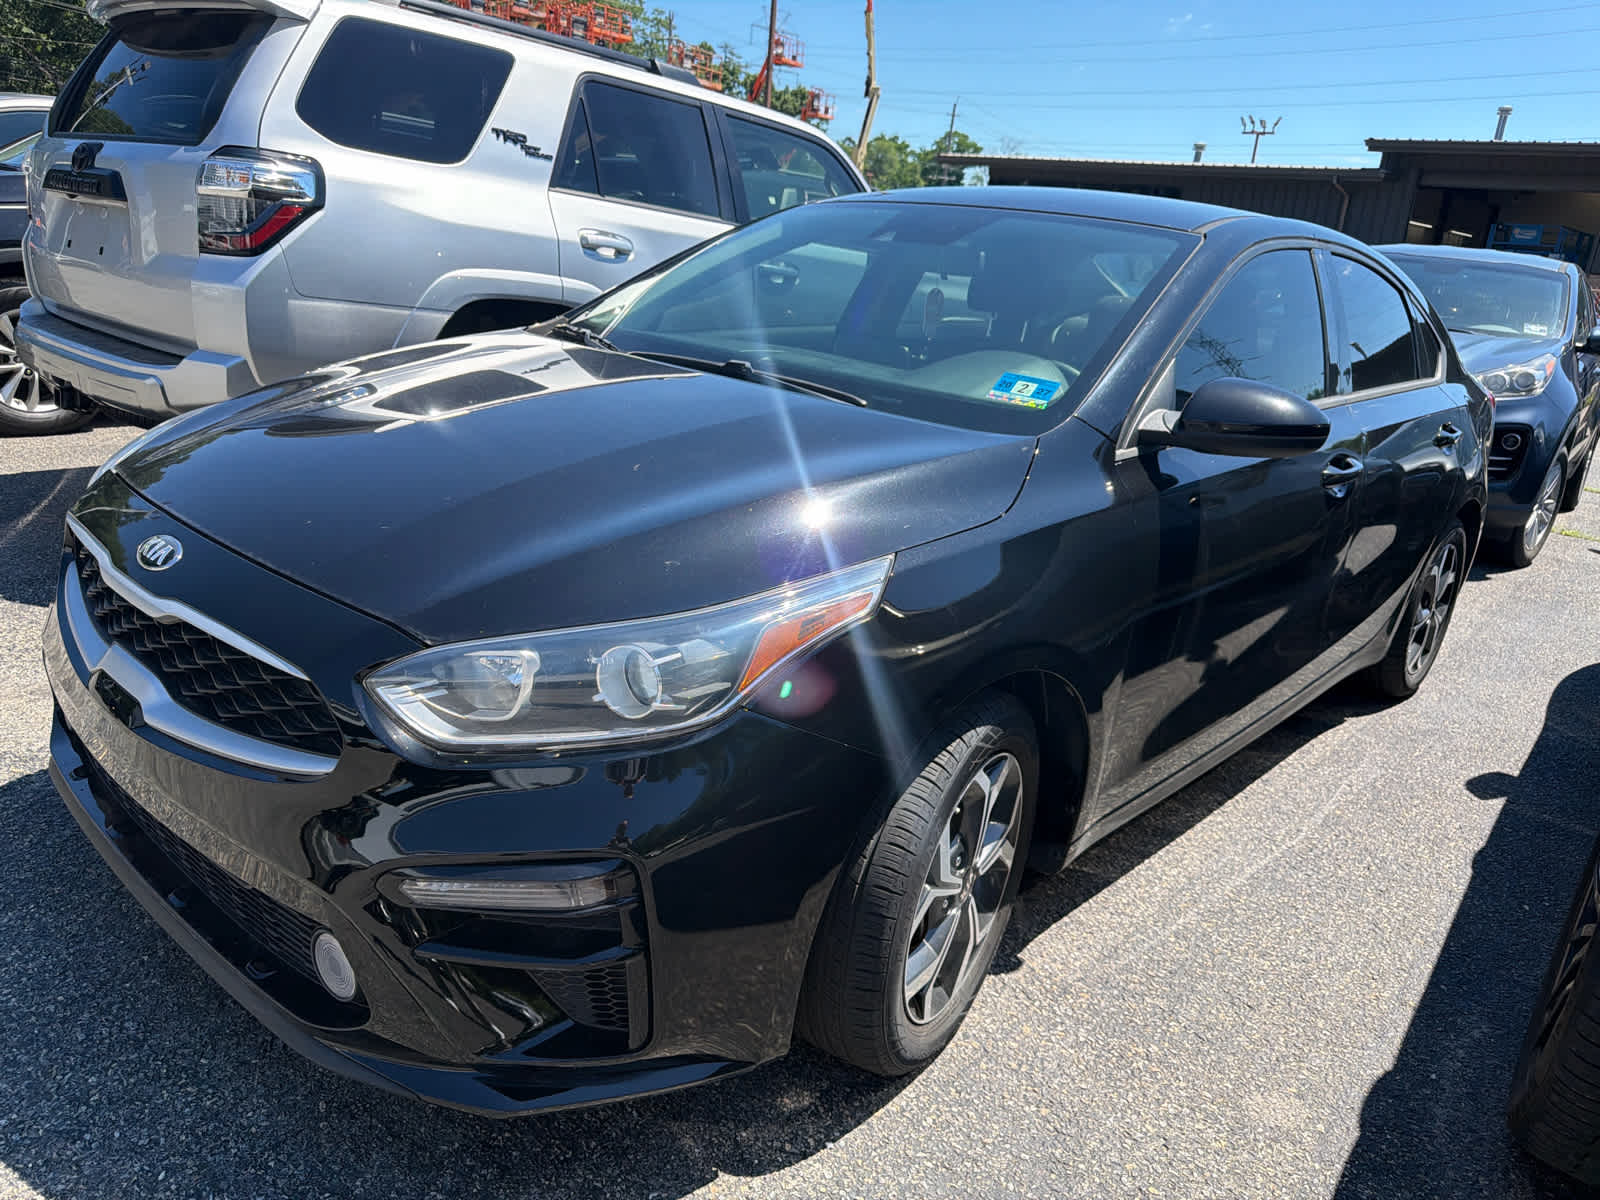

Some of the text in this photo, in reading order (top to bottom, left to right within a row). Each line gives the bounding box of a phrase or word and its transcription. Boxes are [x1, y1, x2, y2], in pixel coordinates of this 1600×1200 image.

[491, 127, 527, 146] TRD
[1017, 383, 1030, 394] 2
[138, 538, 174, 566] KIA
